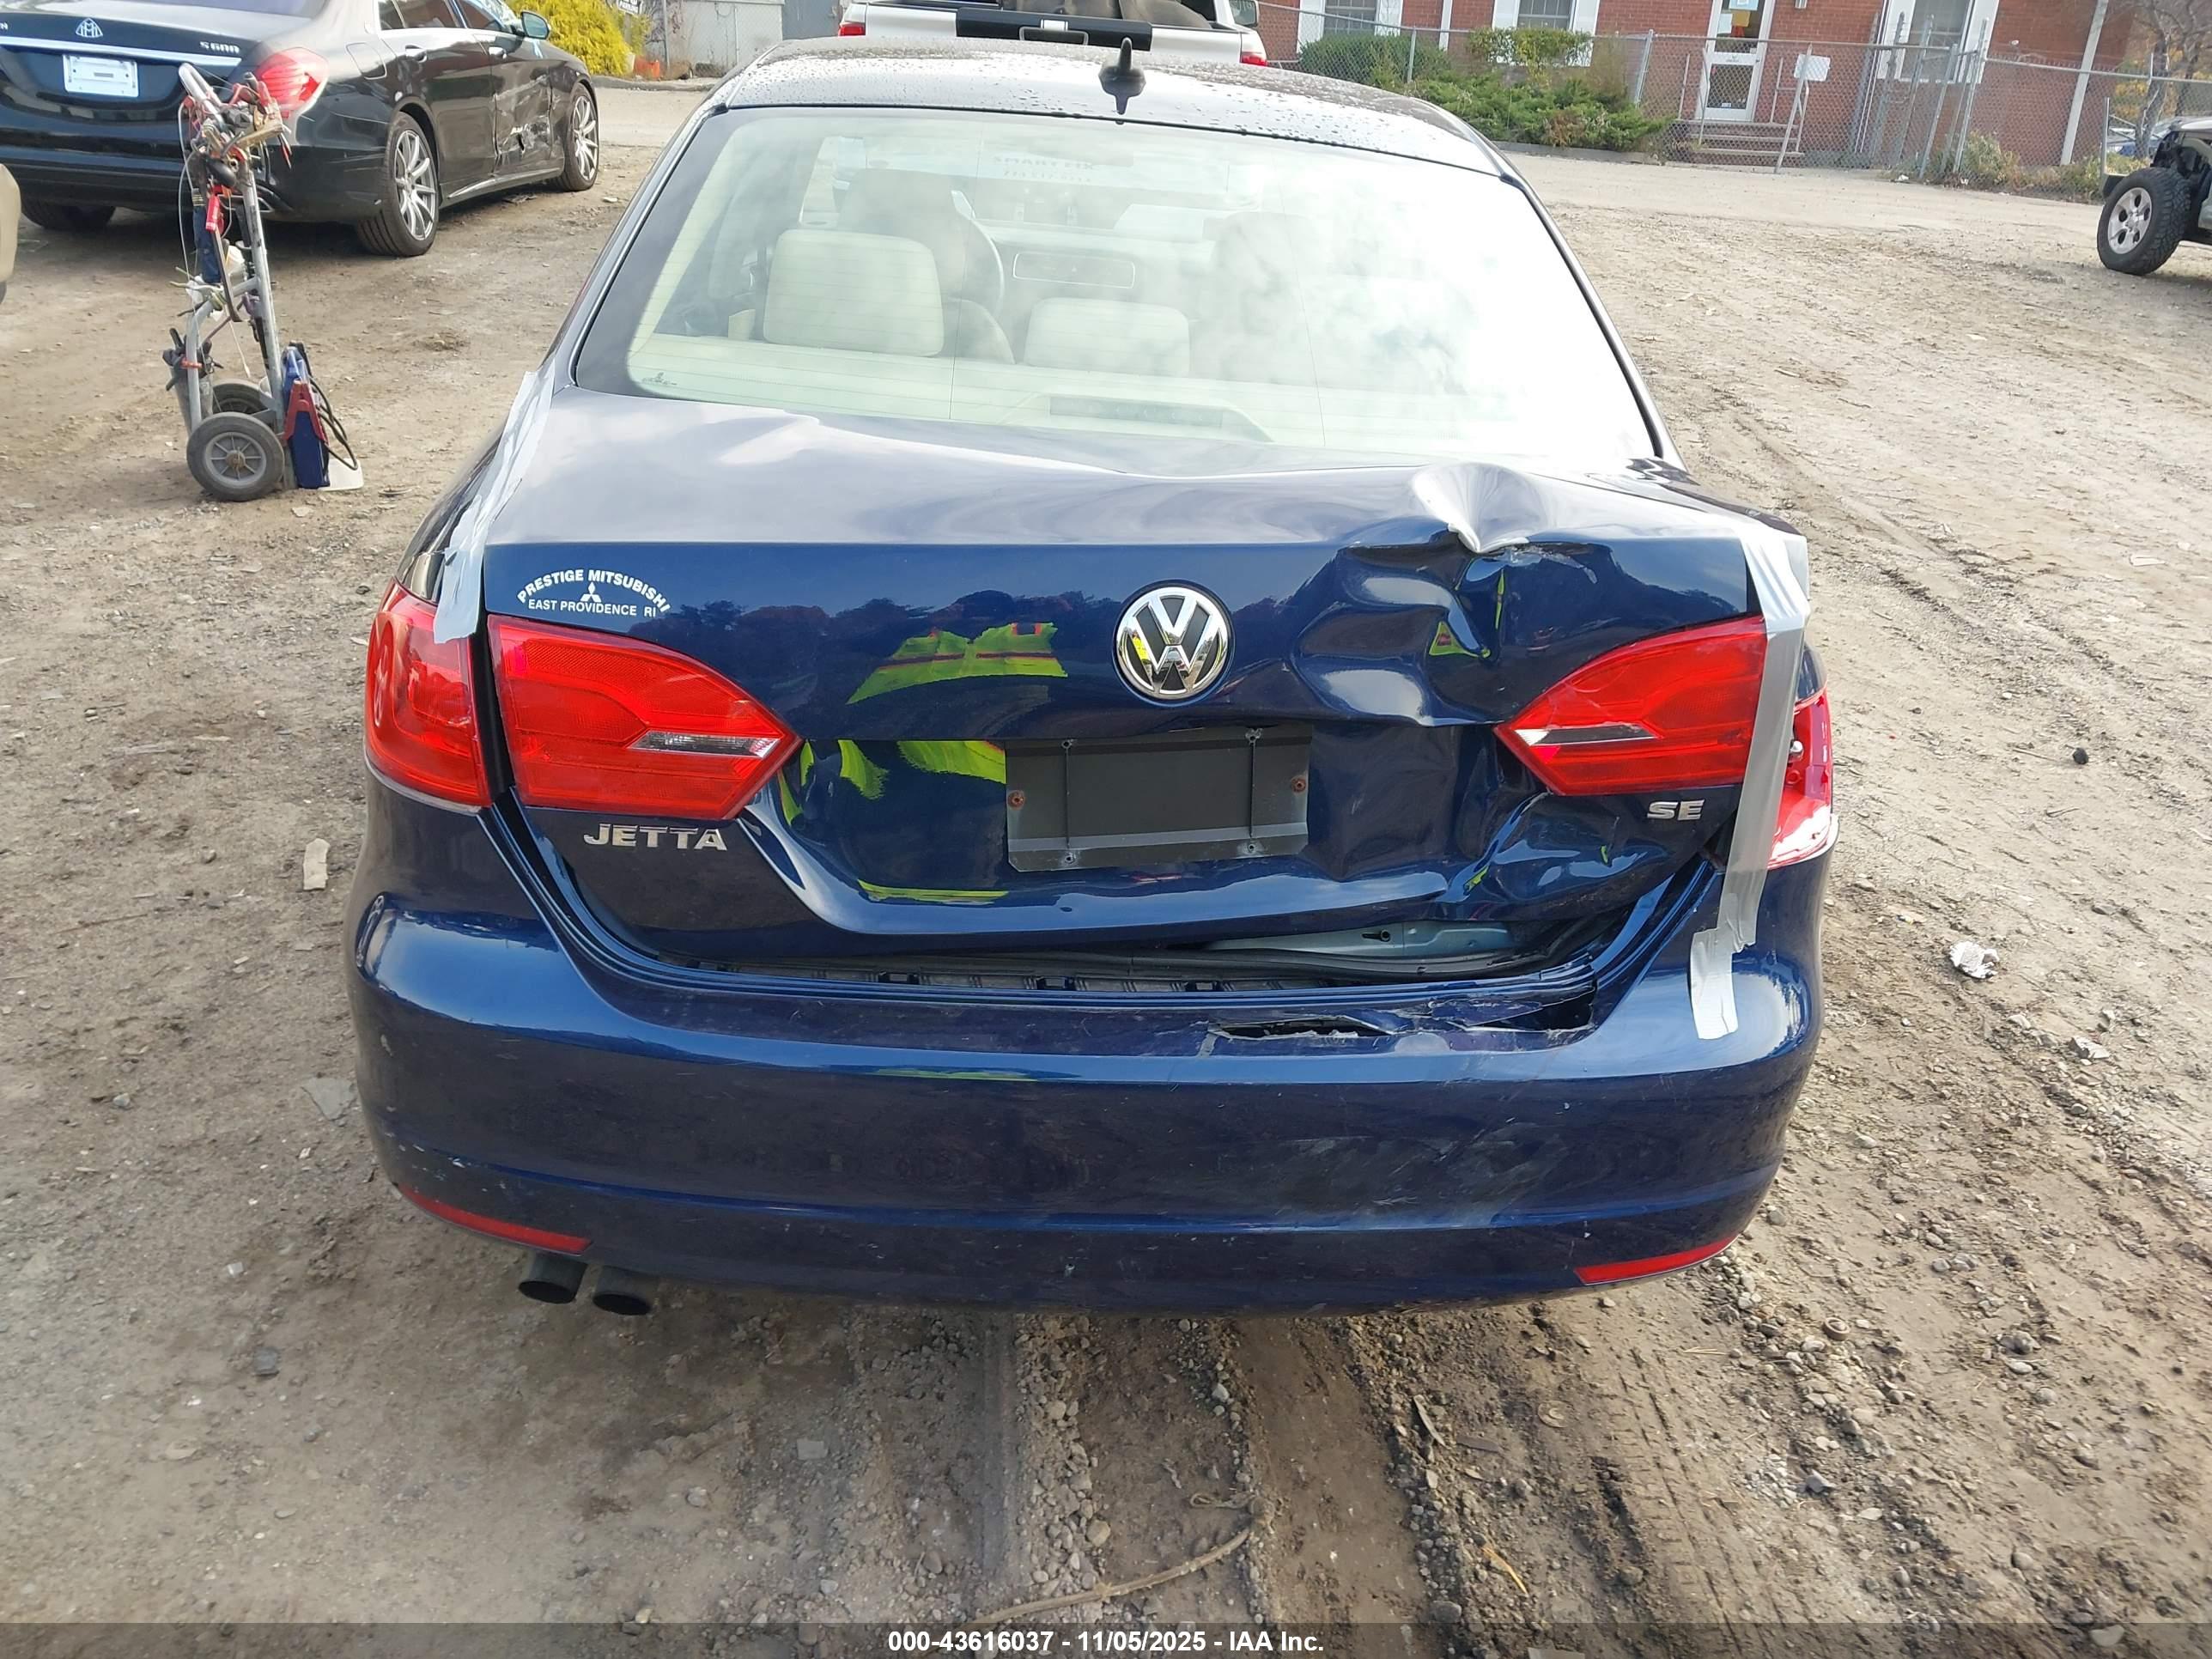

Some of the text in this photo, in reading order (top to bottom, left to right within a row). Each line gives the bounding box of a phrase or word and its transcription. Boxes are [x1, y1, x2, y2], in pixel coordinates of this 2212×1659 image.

[517, 568, 671, 613] PRESTIGE MITSUBISHI
[527, 599, 657, 617] EAST PROVIDENCE RI
[1647, 799, 1705, 821] SE
[583, 823, 728, 851] JETTA
